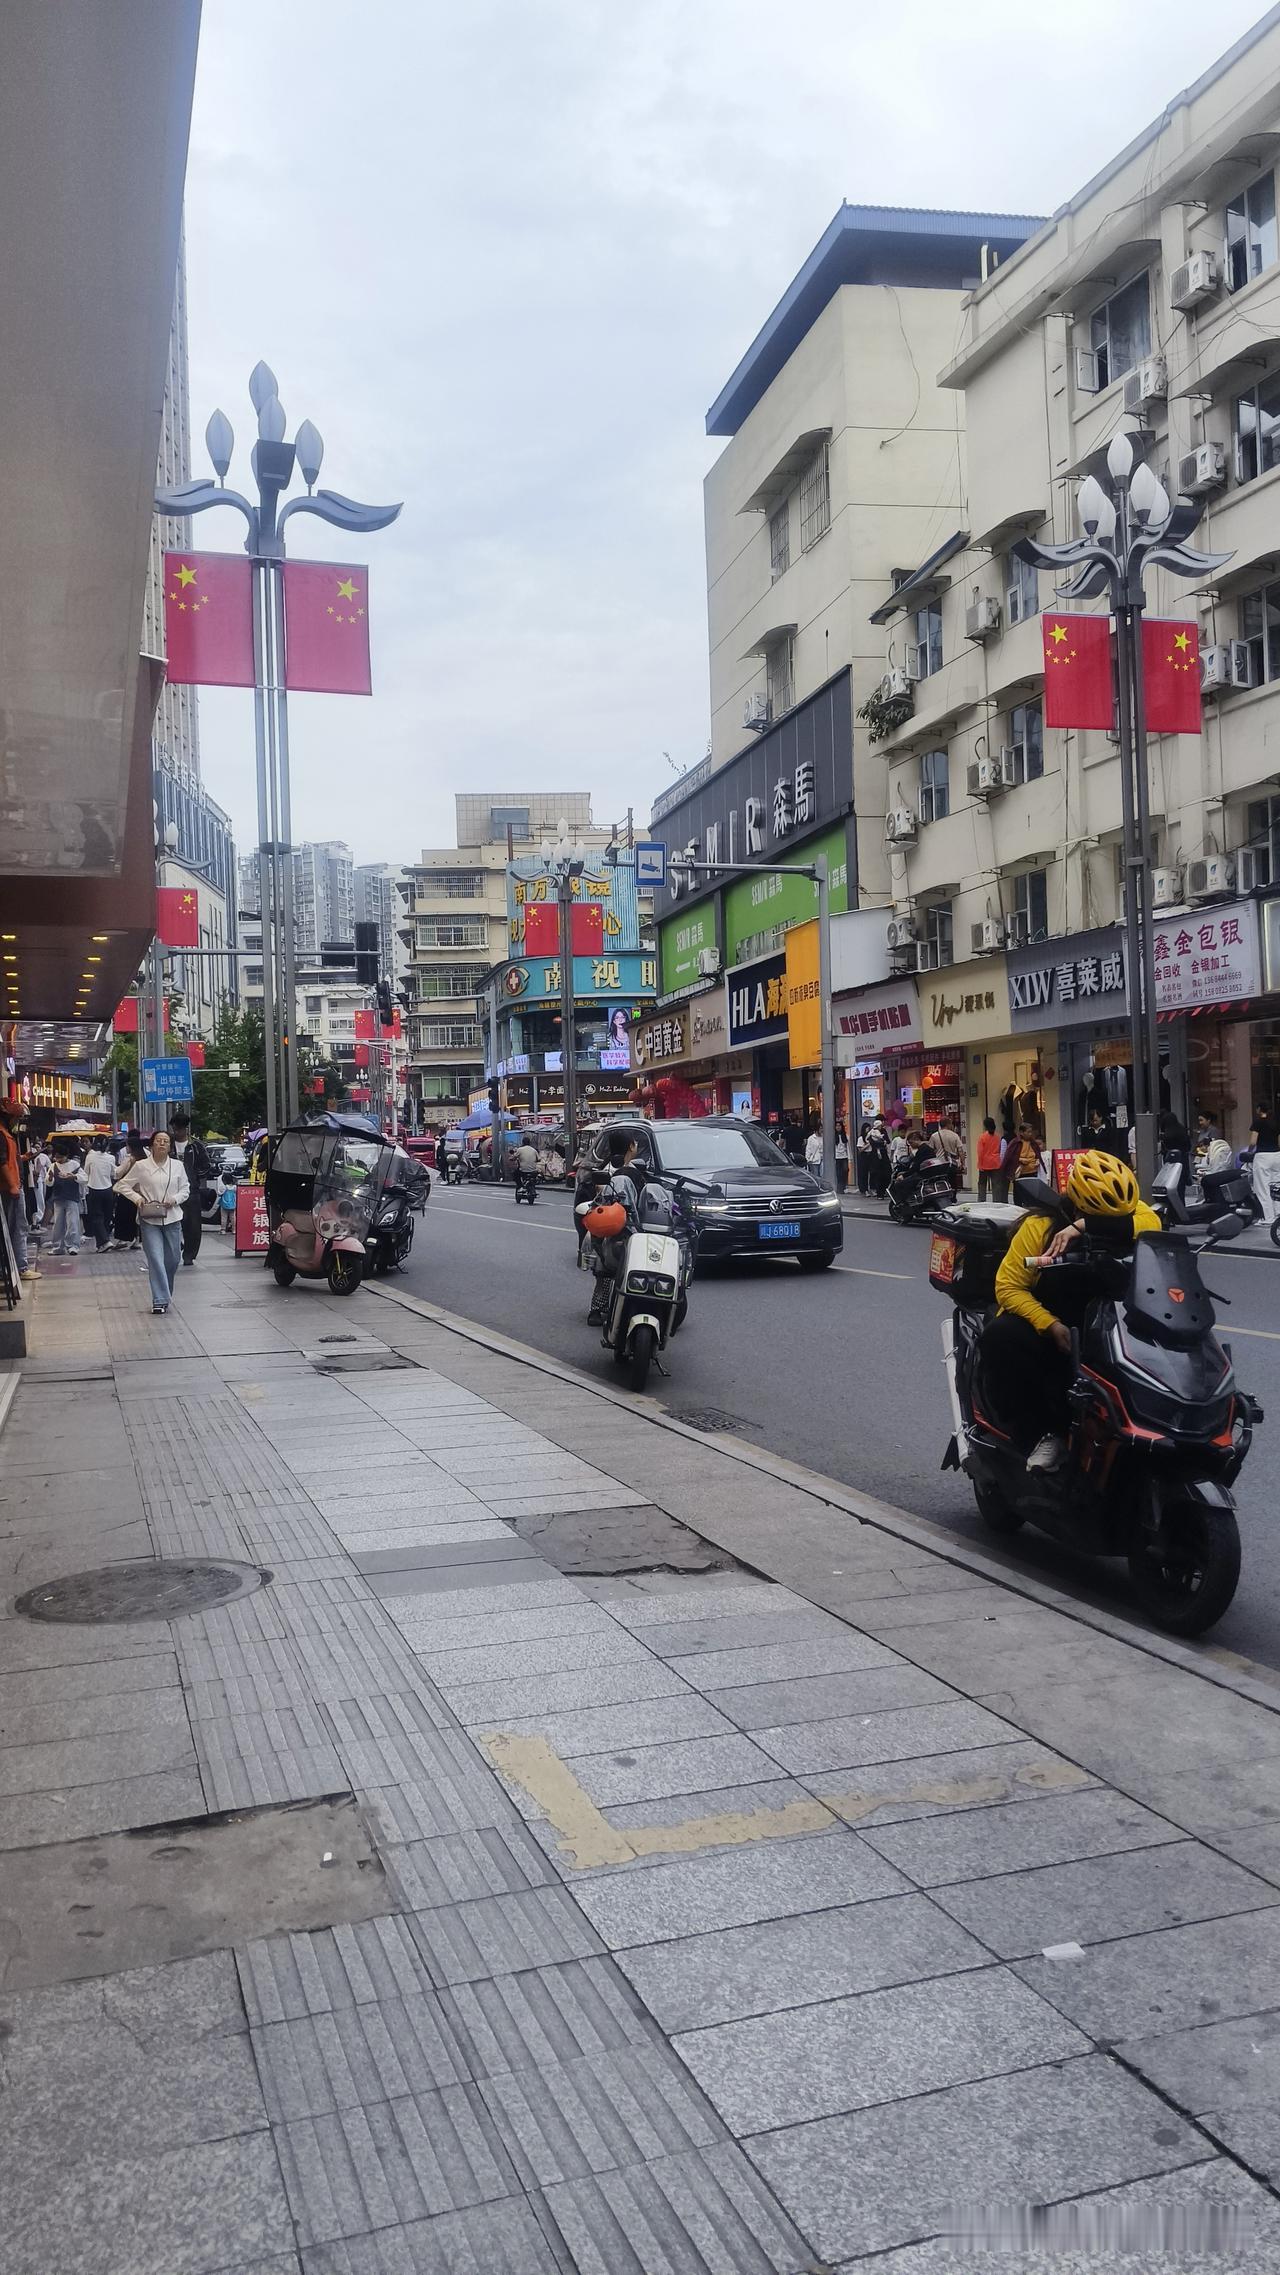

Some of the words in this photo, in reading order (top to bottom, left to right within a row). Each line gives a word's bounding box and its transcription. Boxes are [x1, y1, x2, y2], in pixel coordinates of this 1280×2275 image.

[671, 796, 762, 900] SEMIR
[773, 761, 815, 839] 森馬
[1056, 952, 1125, 1002] 喜莱威
[1191, 955, 1231, 975] 金银加工
[732, 982, 767, 1029] HLA
[644, 1018, 683, 1059] 中国黄金
[160, 1075, 185, 1085] 出租车
[253, 1195, 270, 1245] 追银族
